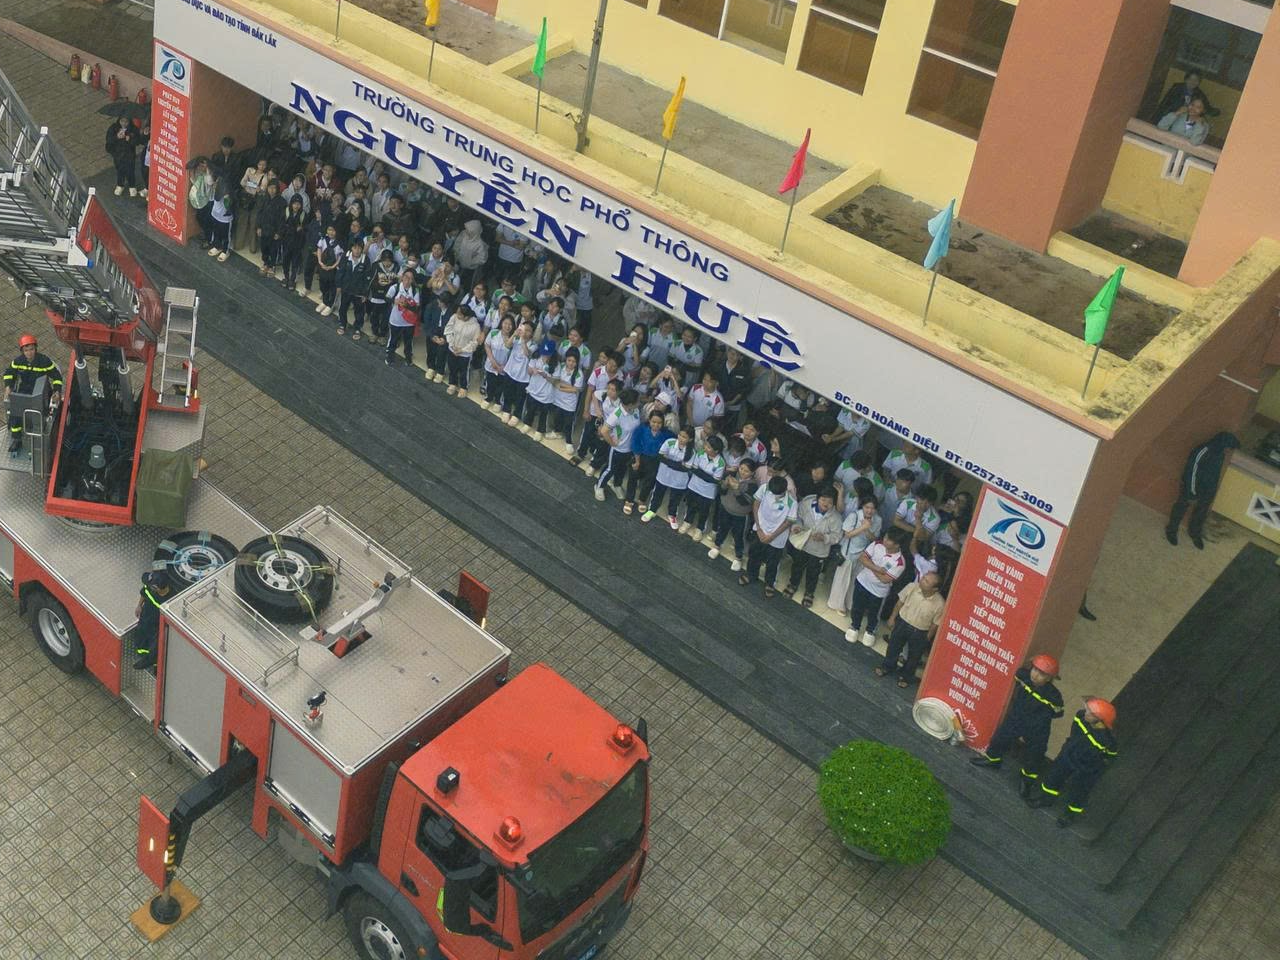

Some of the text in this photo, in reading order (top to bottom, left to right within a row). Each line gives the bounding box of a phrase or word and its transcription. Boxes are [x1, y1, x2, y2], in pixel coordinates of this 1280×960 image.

[288, 82, 806, 373] NGUYỄN HUỆ
[352, 80, 730, 283] TRƯỜNG TRUNG HỌC PHỔ THÔNG
[834, 391, 854, 408] ĐC:
[855, 402, 870, 415] 09
[871, 410, 910, 438] HOÀNG
[945, 449, 964, 467] ĐT:
